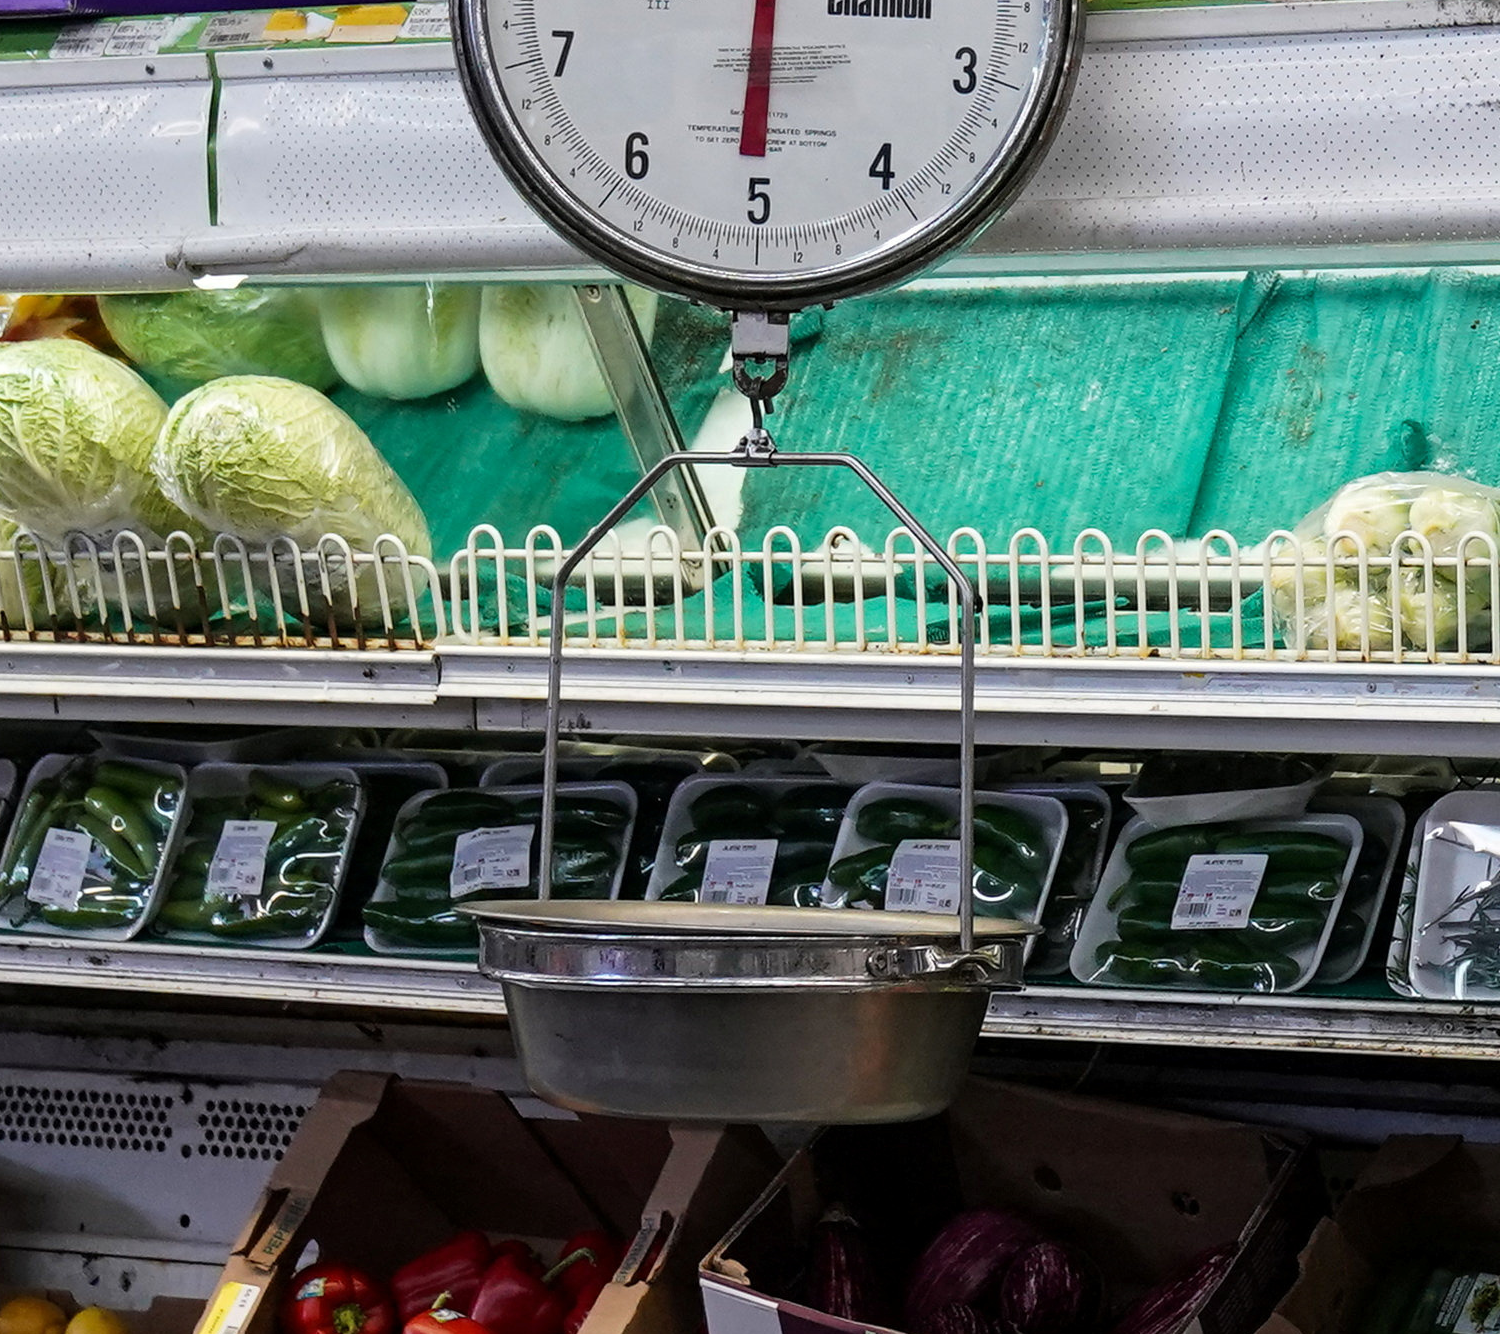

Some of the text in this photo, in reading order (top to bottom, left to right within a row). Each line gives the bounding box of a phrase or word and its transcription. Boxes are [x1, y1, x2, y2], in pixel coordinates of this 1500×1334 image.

[552, 32, 573, 76] 7
[953, 49, 976, 93] 3
[687, 124, 837, 138] TEMPERATURE SPRINGS
[625, 133, 649, 179] 6
[869, 143, 895, 189] 4
[748, 178, 770, 224] 5
